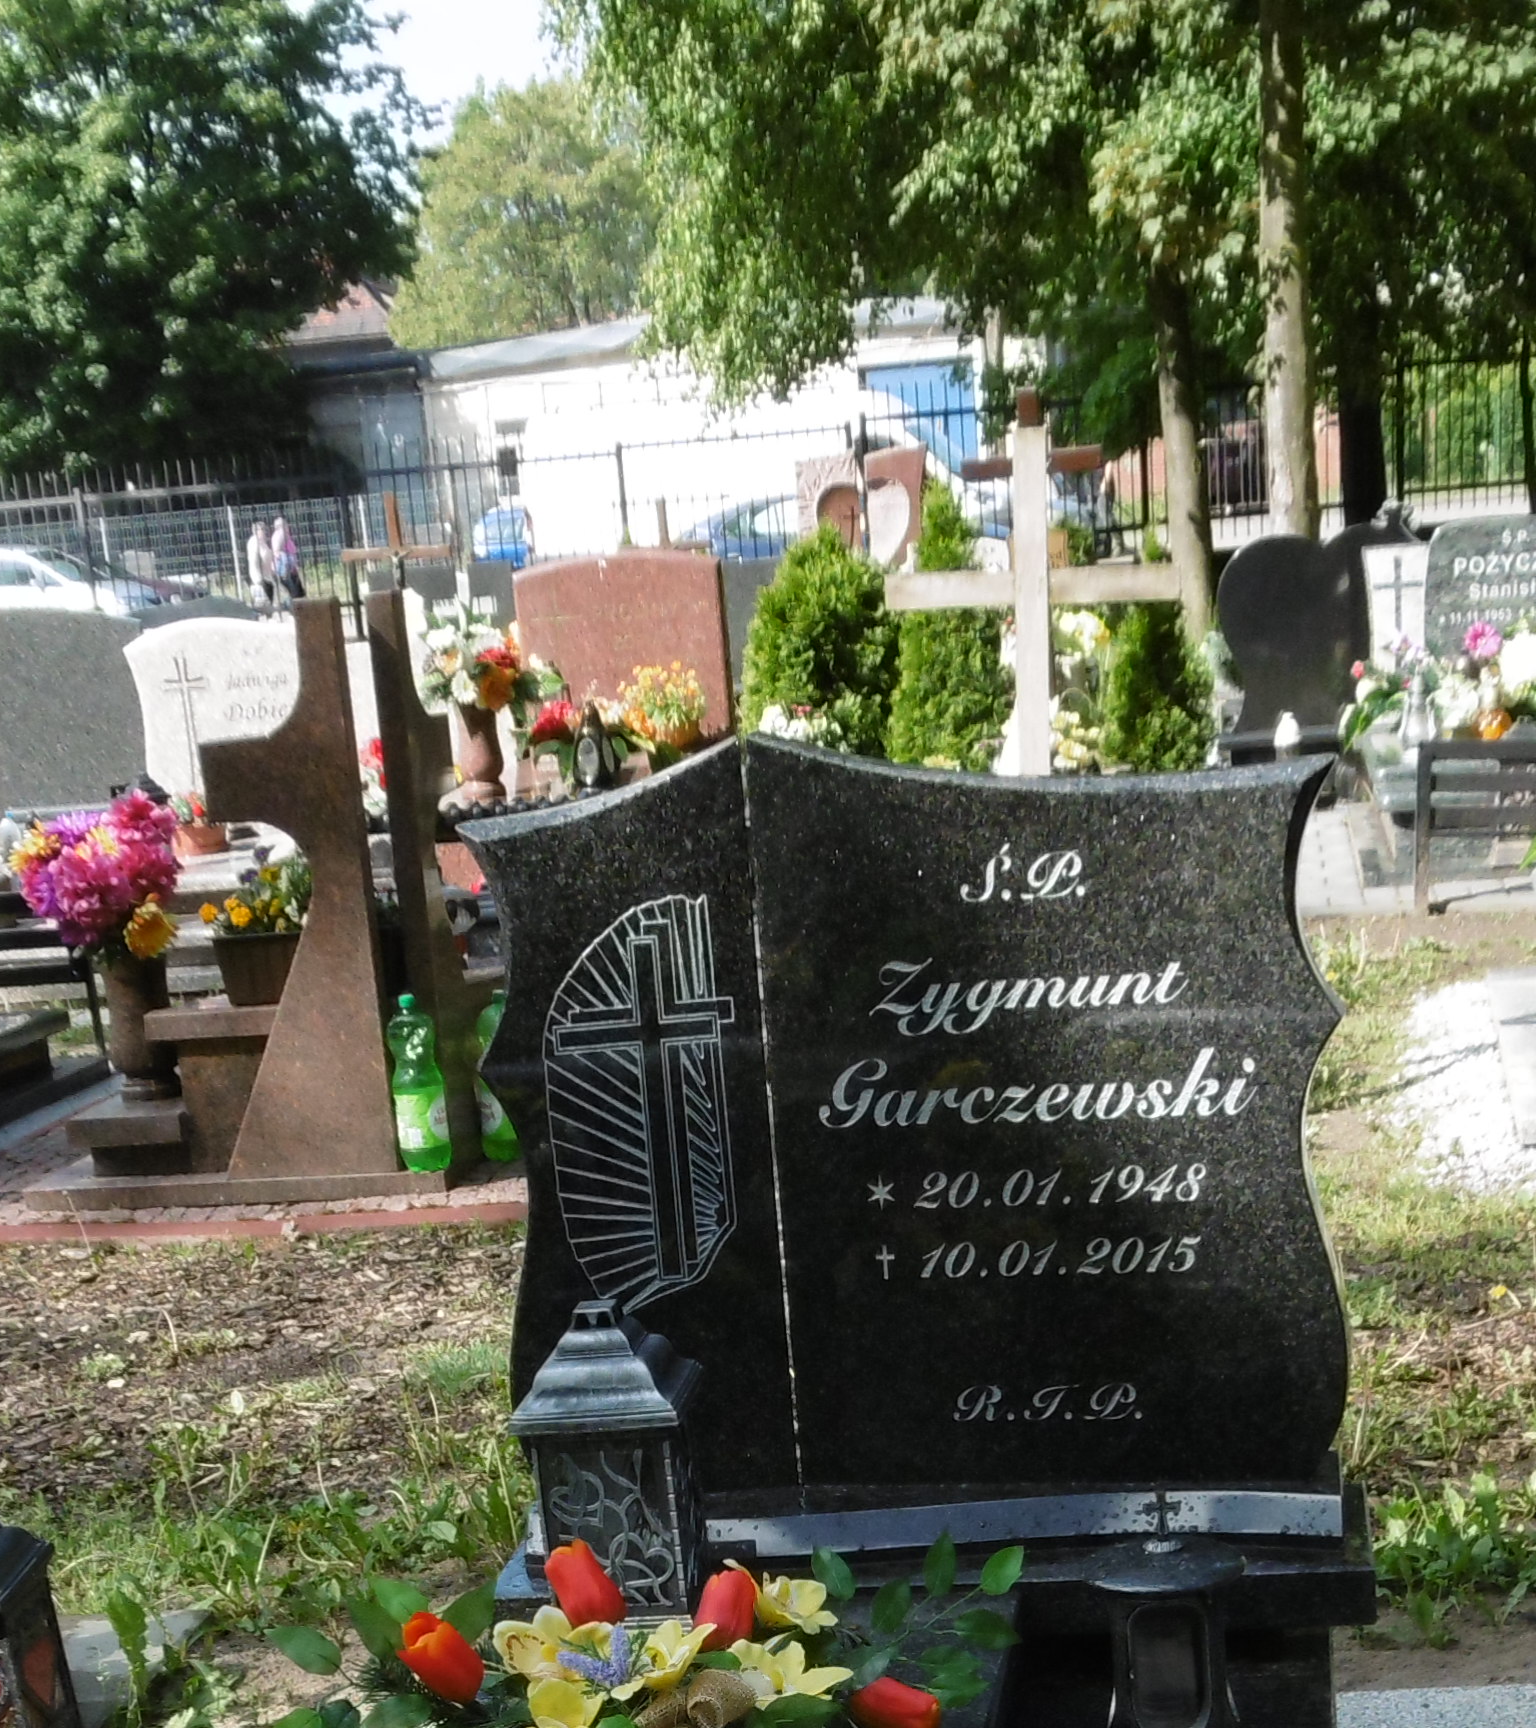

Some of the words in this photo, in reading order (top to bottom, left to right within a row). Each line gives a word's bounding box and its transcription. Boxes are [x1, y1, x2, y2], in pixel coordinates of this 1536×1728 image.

[869, 956, 1190, 1037] Zygmunt
[818, 1045, 1259, 1129] Garczewski
[913, 1162, 1207, 1209] 20.01.1948
[920, 1234, 1202, 1279] 10.01.2015
